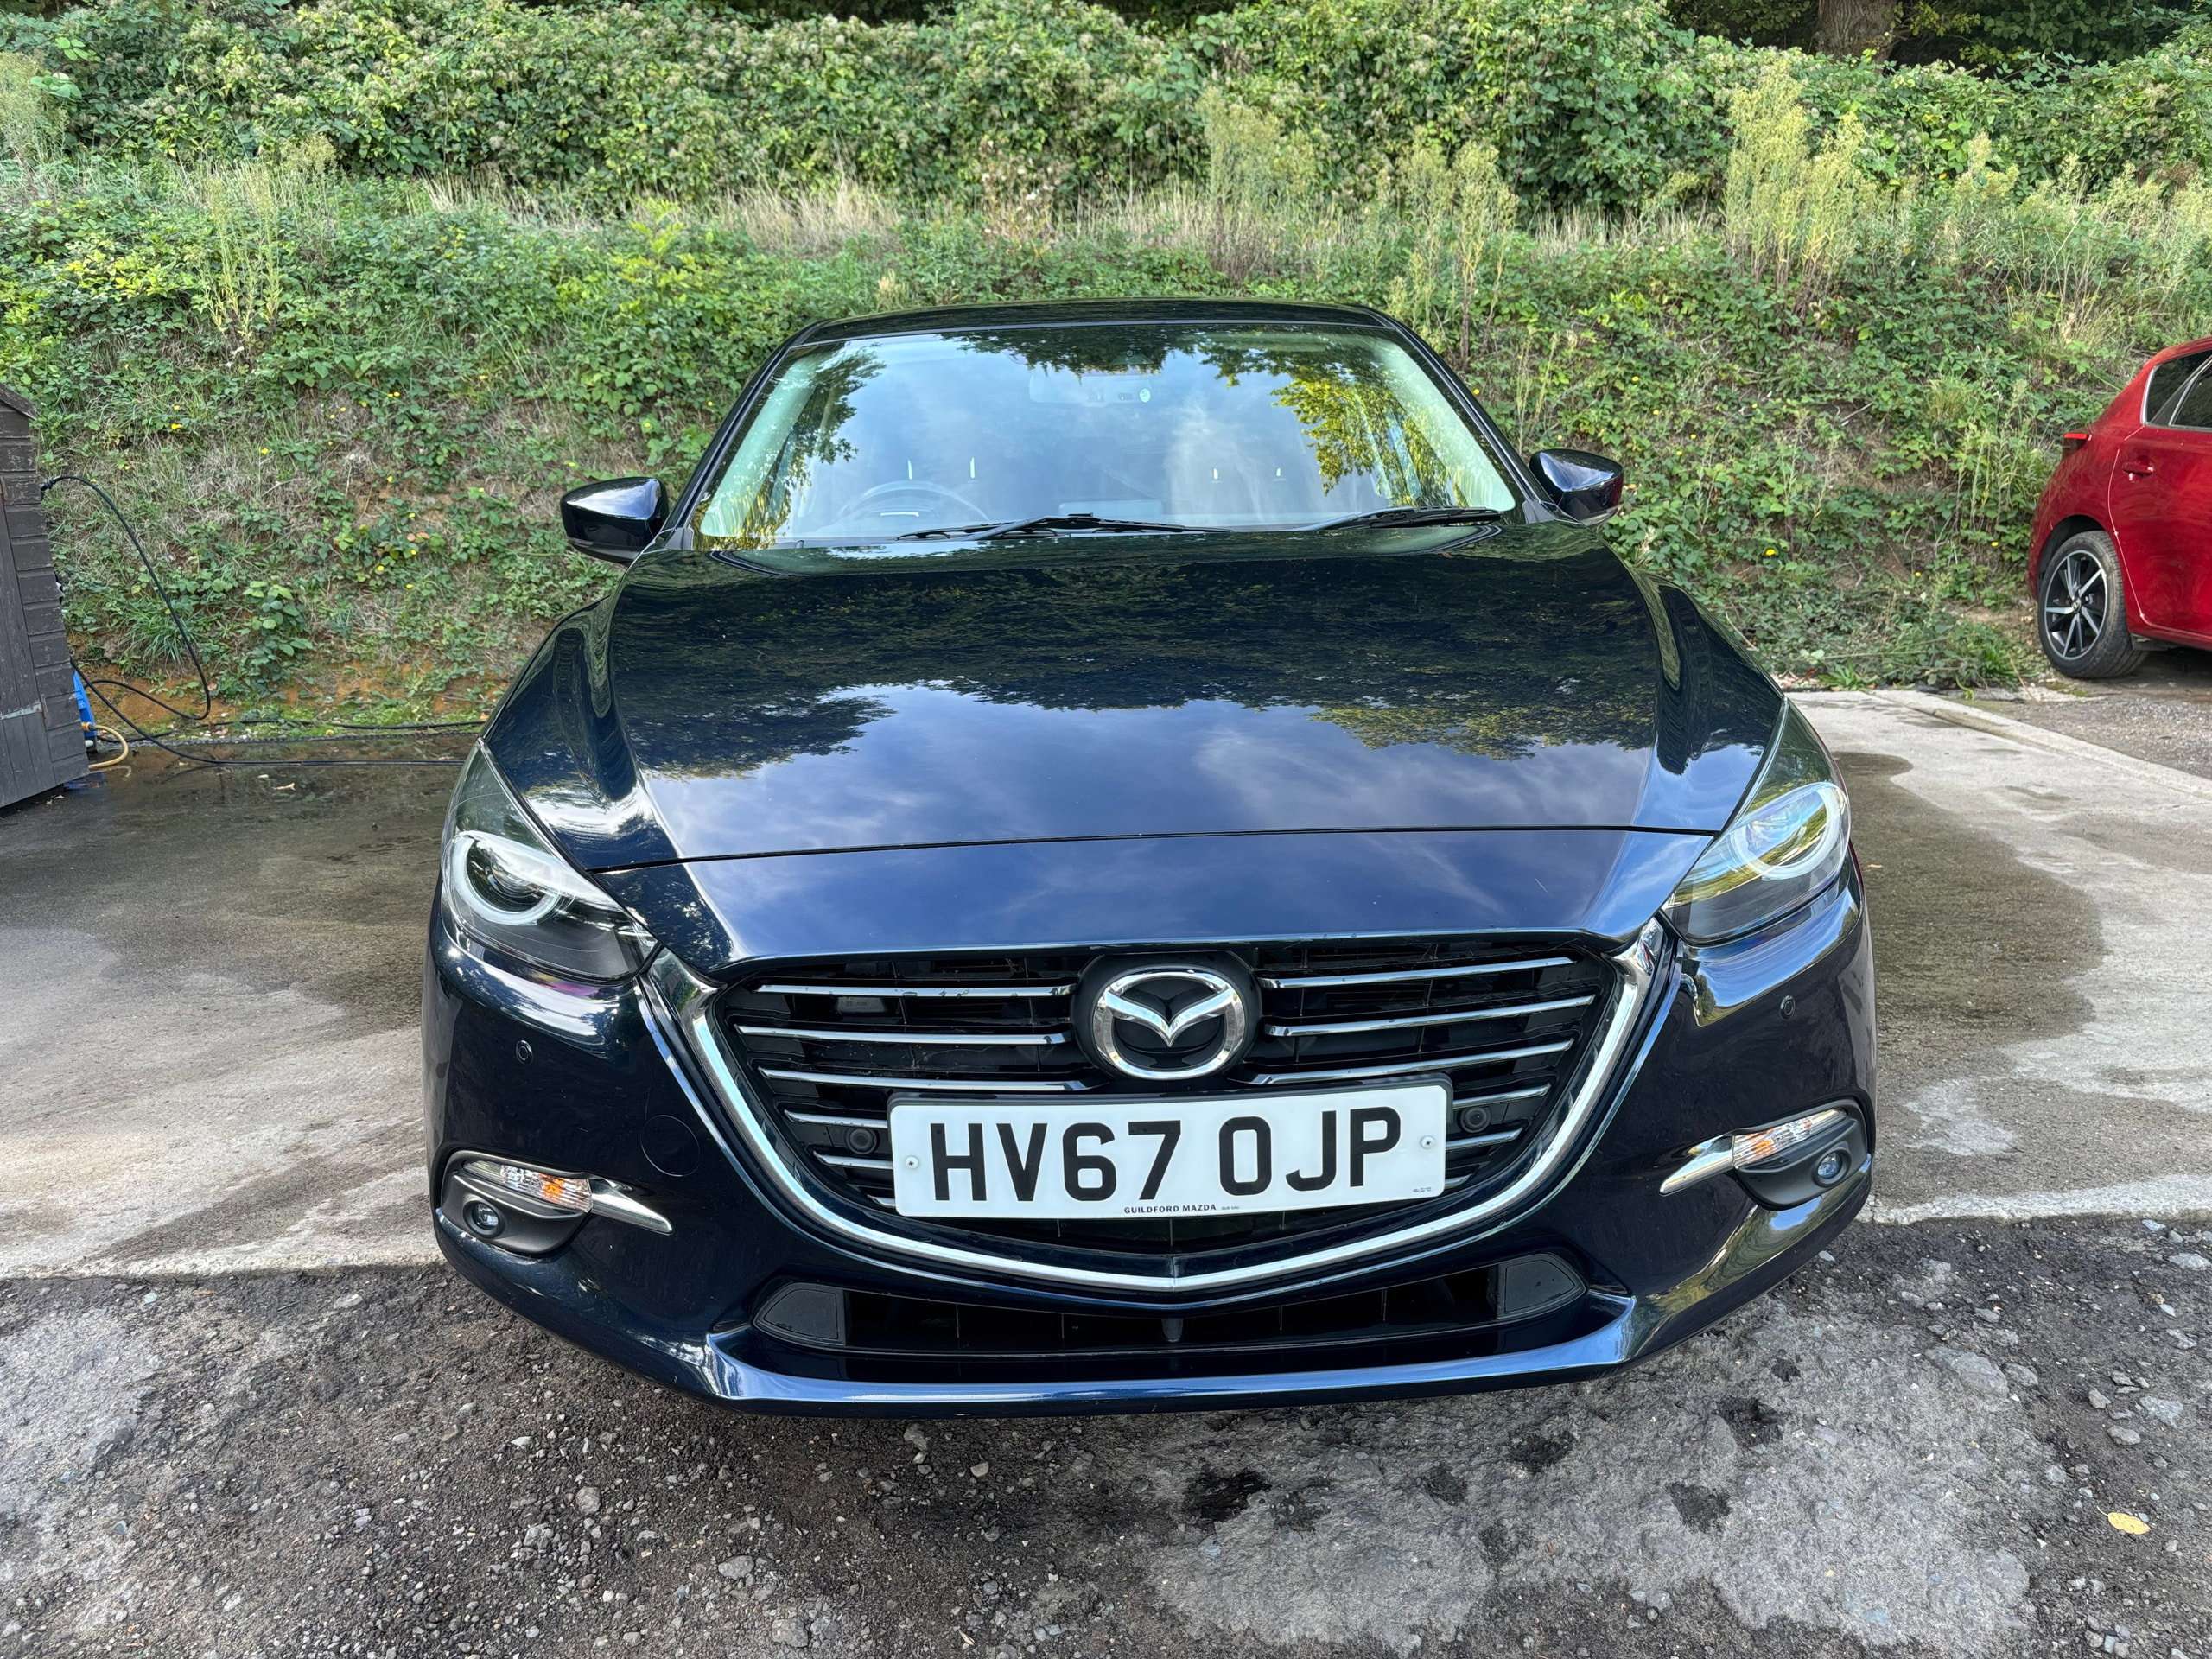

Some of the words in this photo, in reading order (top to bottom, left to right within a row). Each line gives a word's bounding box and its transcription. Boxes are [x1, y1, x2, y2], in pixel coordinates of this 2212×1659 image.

[930, 1120, 1181, 1202] HV67
[1218, 1106, 1401, 1196] OJP
[1124, 1205, 1179, 1214] GUILDFORD
